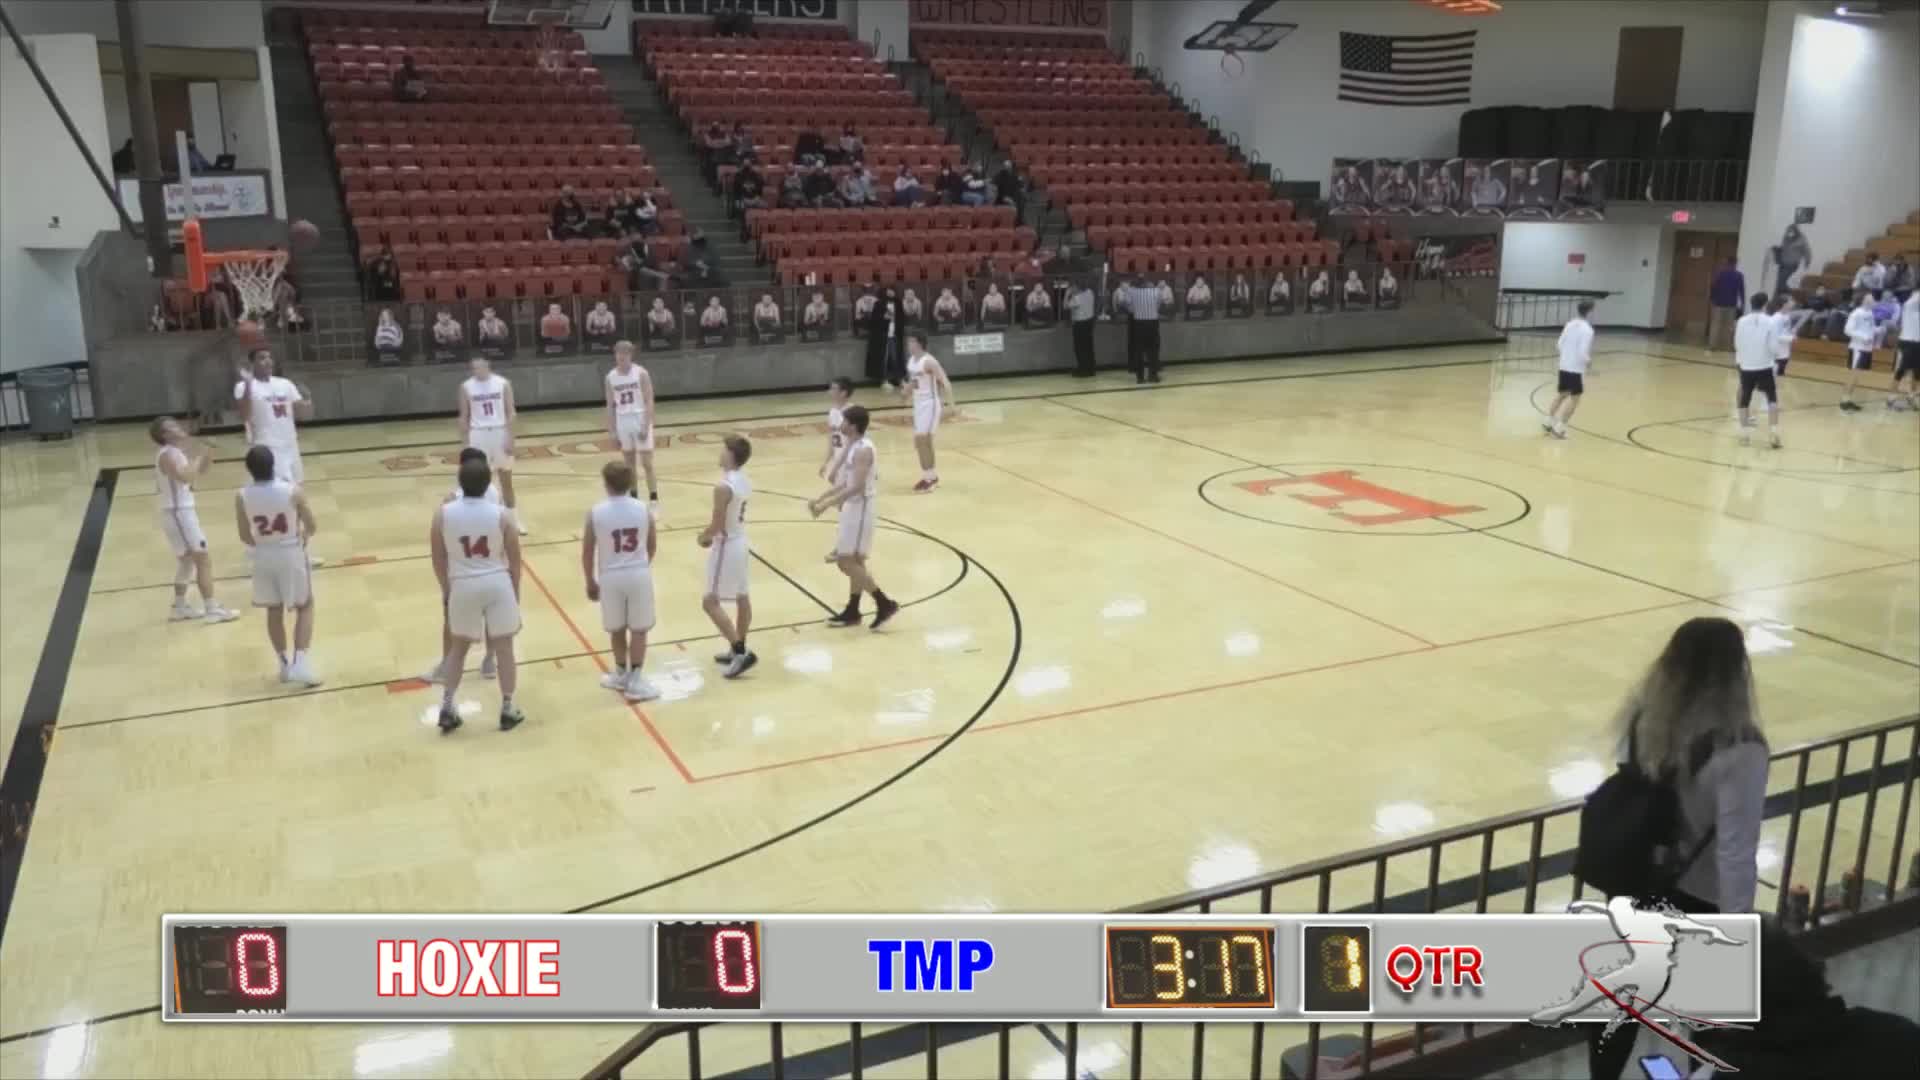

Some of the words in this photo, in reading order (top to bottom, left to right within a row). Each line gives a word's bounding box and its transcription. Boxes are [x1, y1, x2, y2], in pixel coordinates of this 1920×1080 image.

[482, 401, 494, 416] 11
[253, 512, 288, 535] 24
[459, 535, 490, 558] 14
[611, 527, 639, 553] 13
